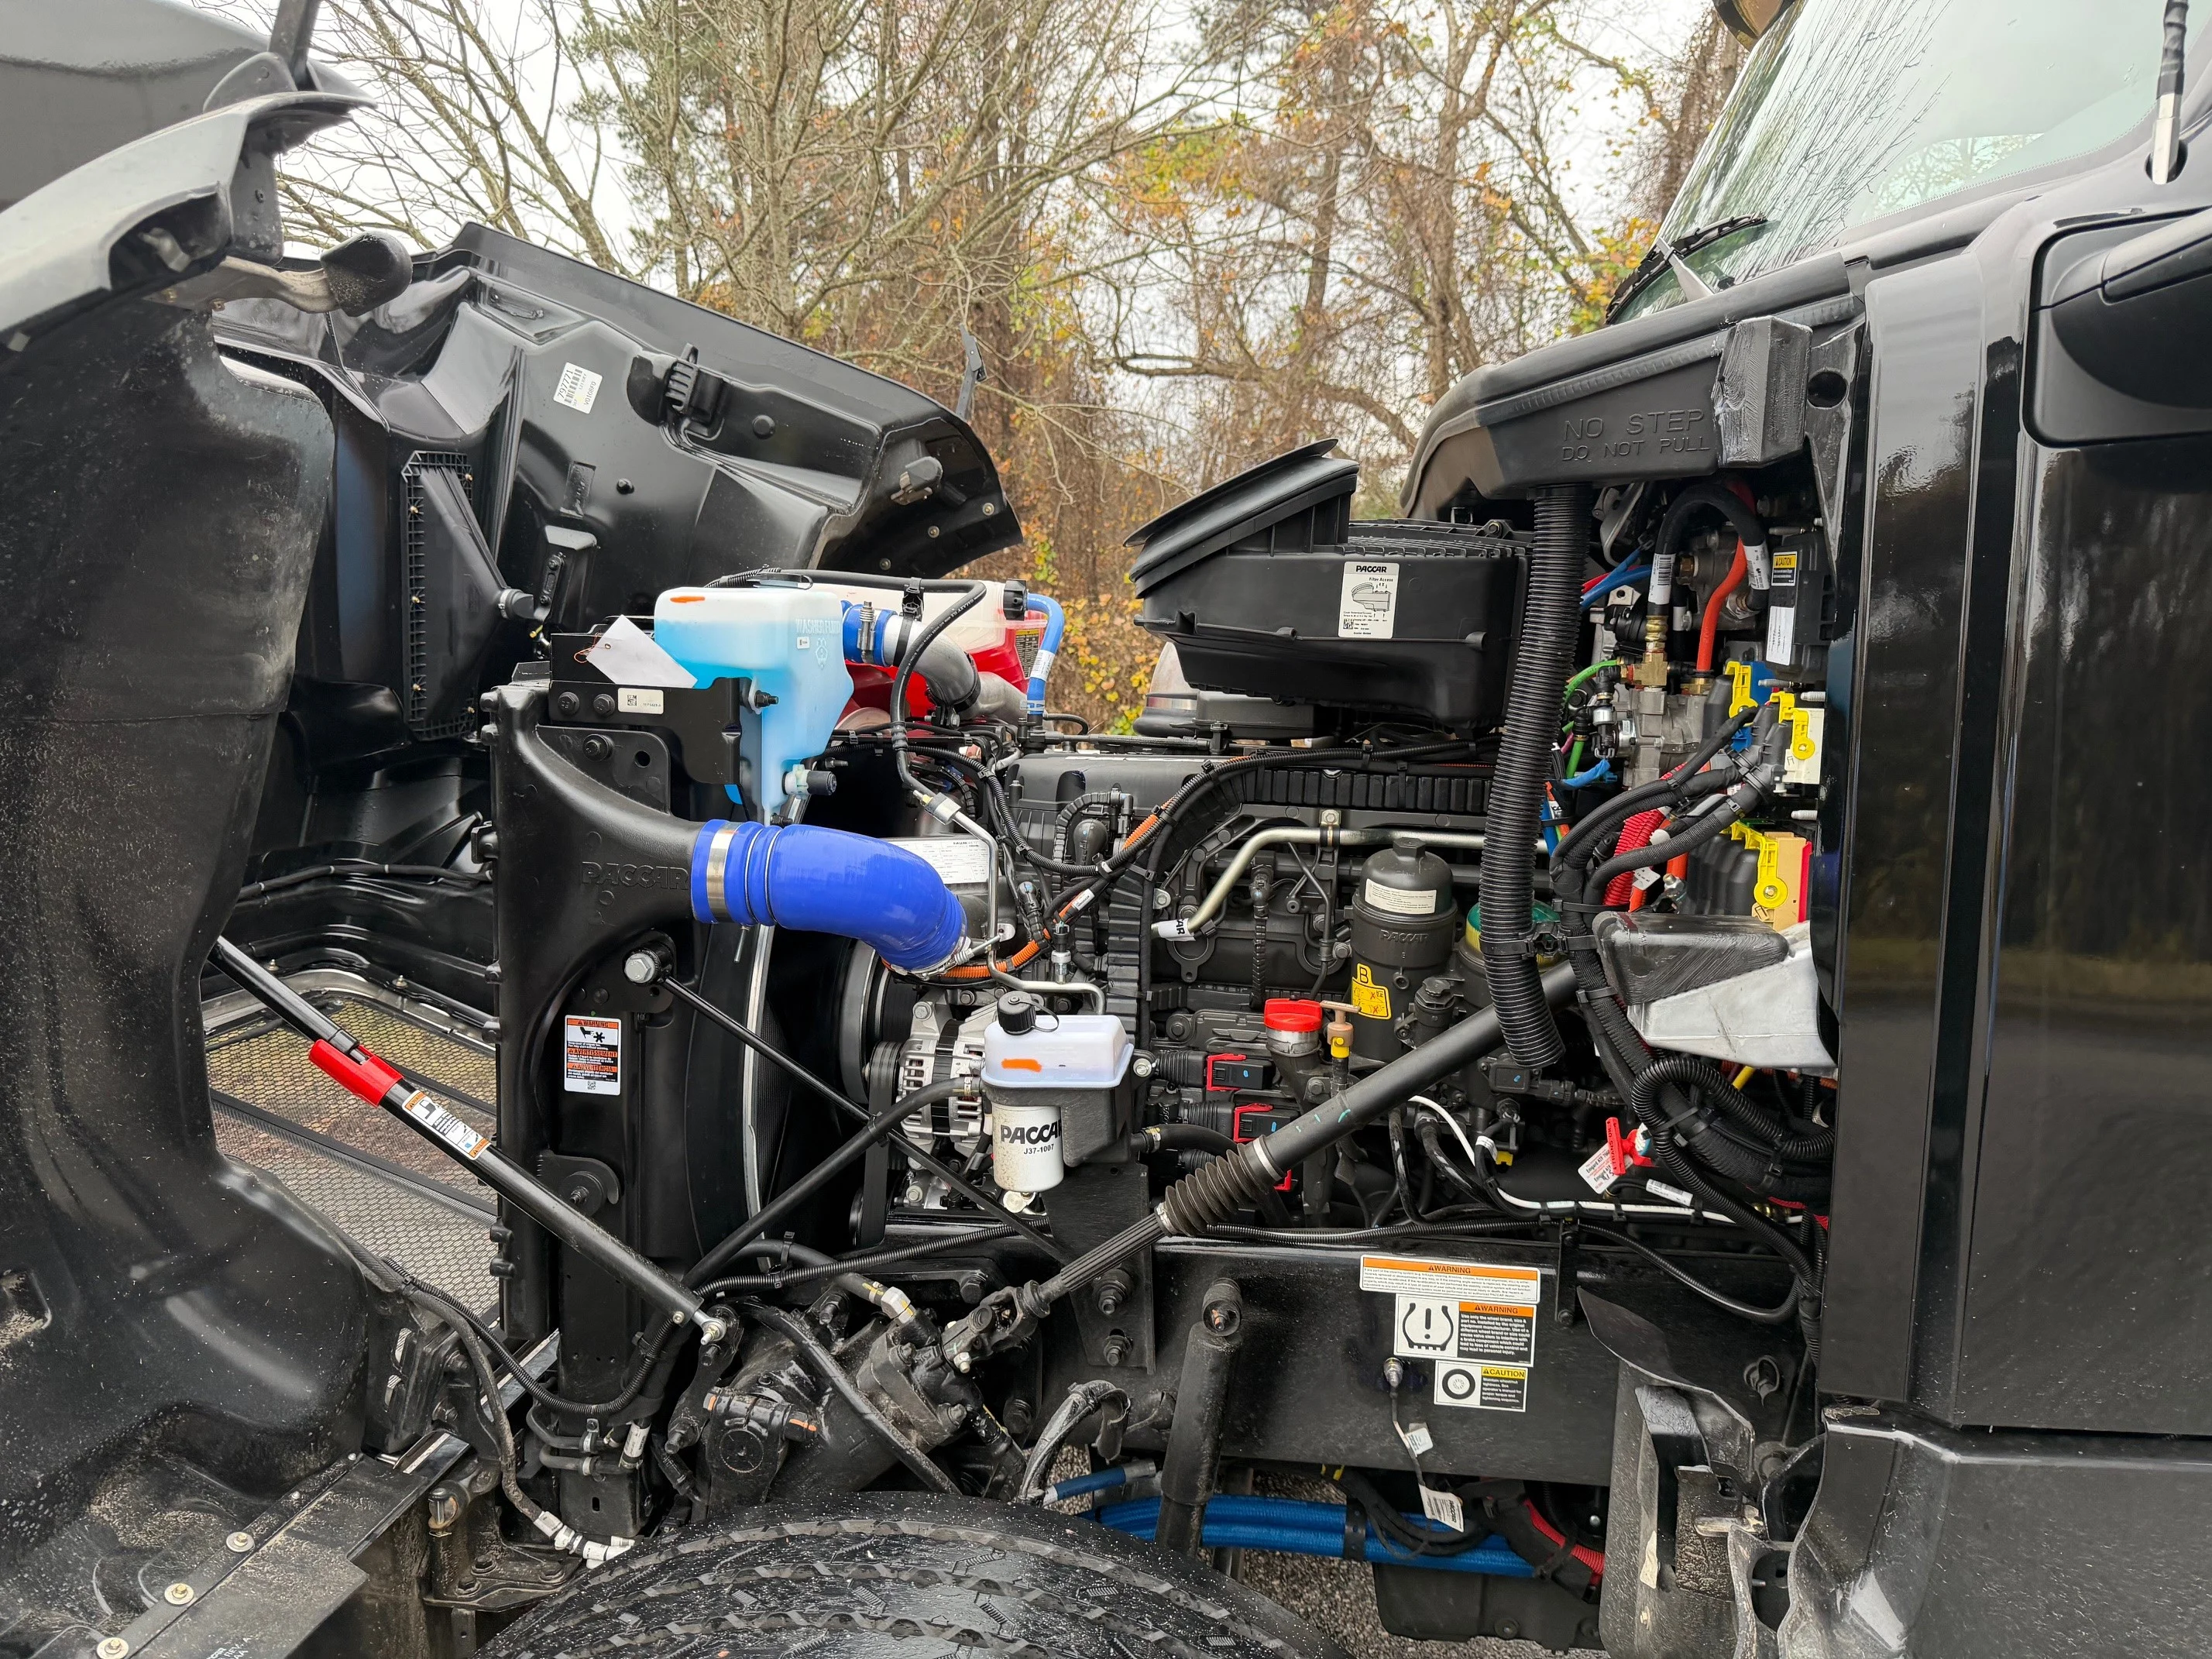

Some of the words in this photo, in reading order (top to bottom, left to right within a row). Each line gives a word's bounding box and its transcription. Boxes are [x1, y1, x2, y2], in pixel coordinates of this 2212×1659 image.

[557, 369, 573, 399] 797771
[1563, 417, 1603, 441] NO
[1626, 409, 1704, 434] STEP
[1561, 445, 1589, 461] DO
[1604, 441, 1645, 458] NOT
[1660, 436, 1710, 454] PULL
[957, 598, 974, 613] GALAXY
[582, 861, 689, 890] PACCAR
[1359, 967, 1369, 984] B
[1023, 1143, 1054, 1155] J37-1007
[1434, 1265, 1471, 1274] WARNING
[1481, 1305, 1518, 1314] WARNING
